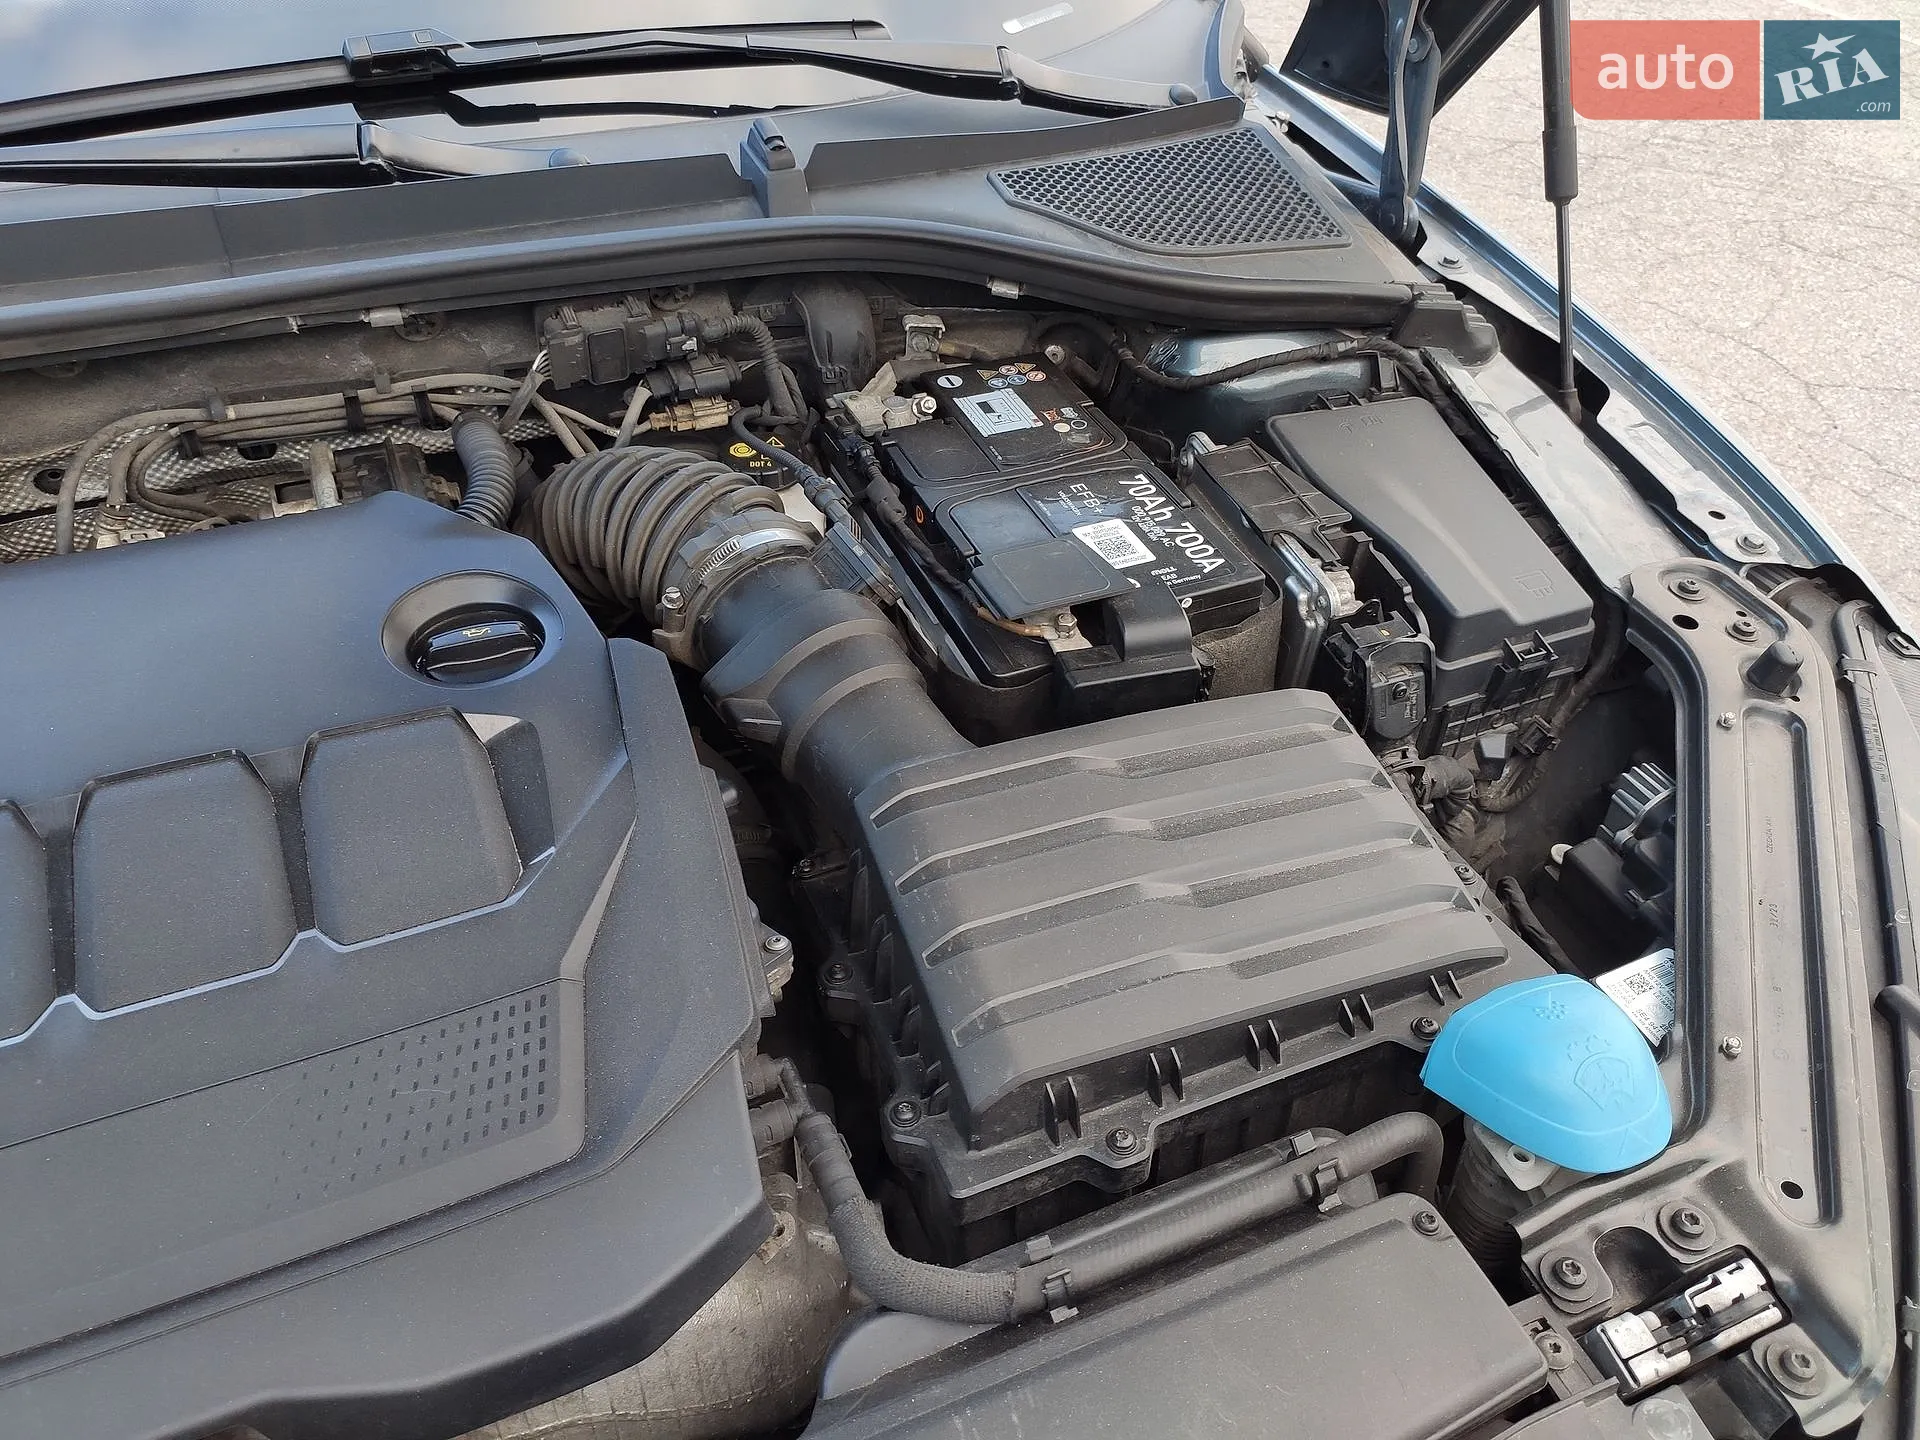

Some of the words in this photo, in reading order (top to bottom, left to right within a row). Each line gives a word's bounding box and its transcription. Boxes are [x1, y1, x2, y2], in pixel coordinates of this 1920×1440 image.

[749, 460, 765, 468] DOT
[1069, 483, 1104, 515] EFB+
[1118, 473, 1176, 522] 70Ah
[1164, 521, 1226, 574] 700A
[1160, 537, 1175, 548] AC
[1172, 574, 1201, 586] Germany
